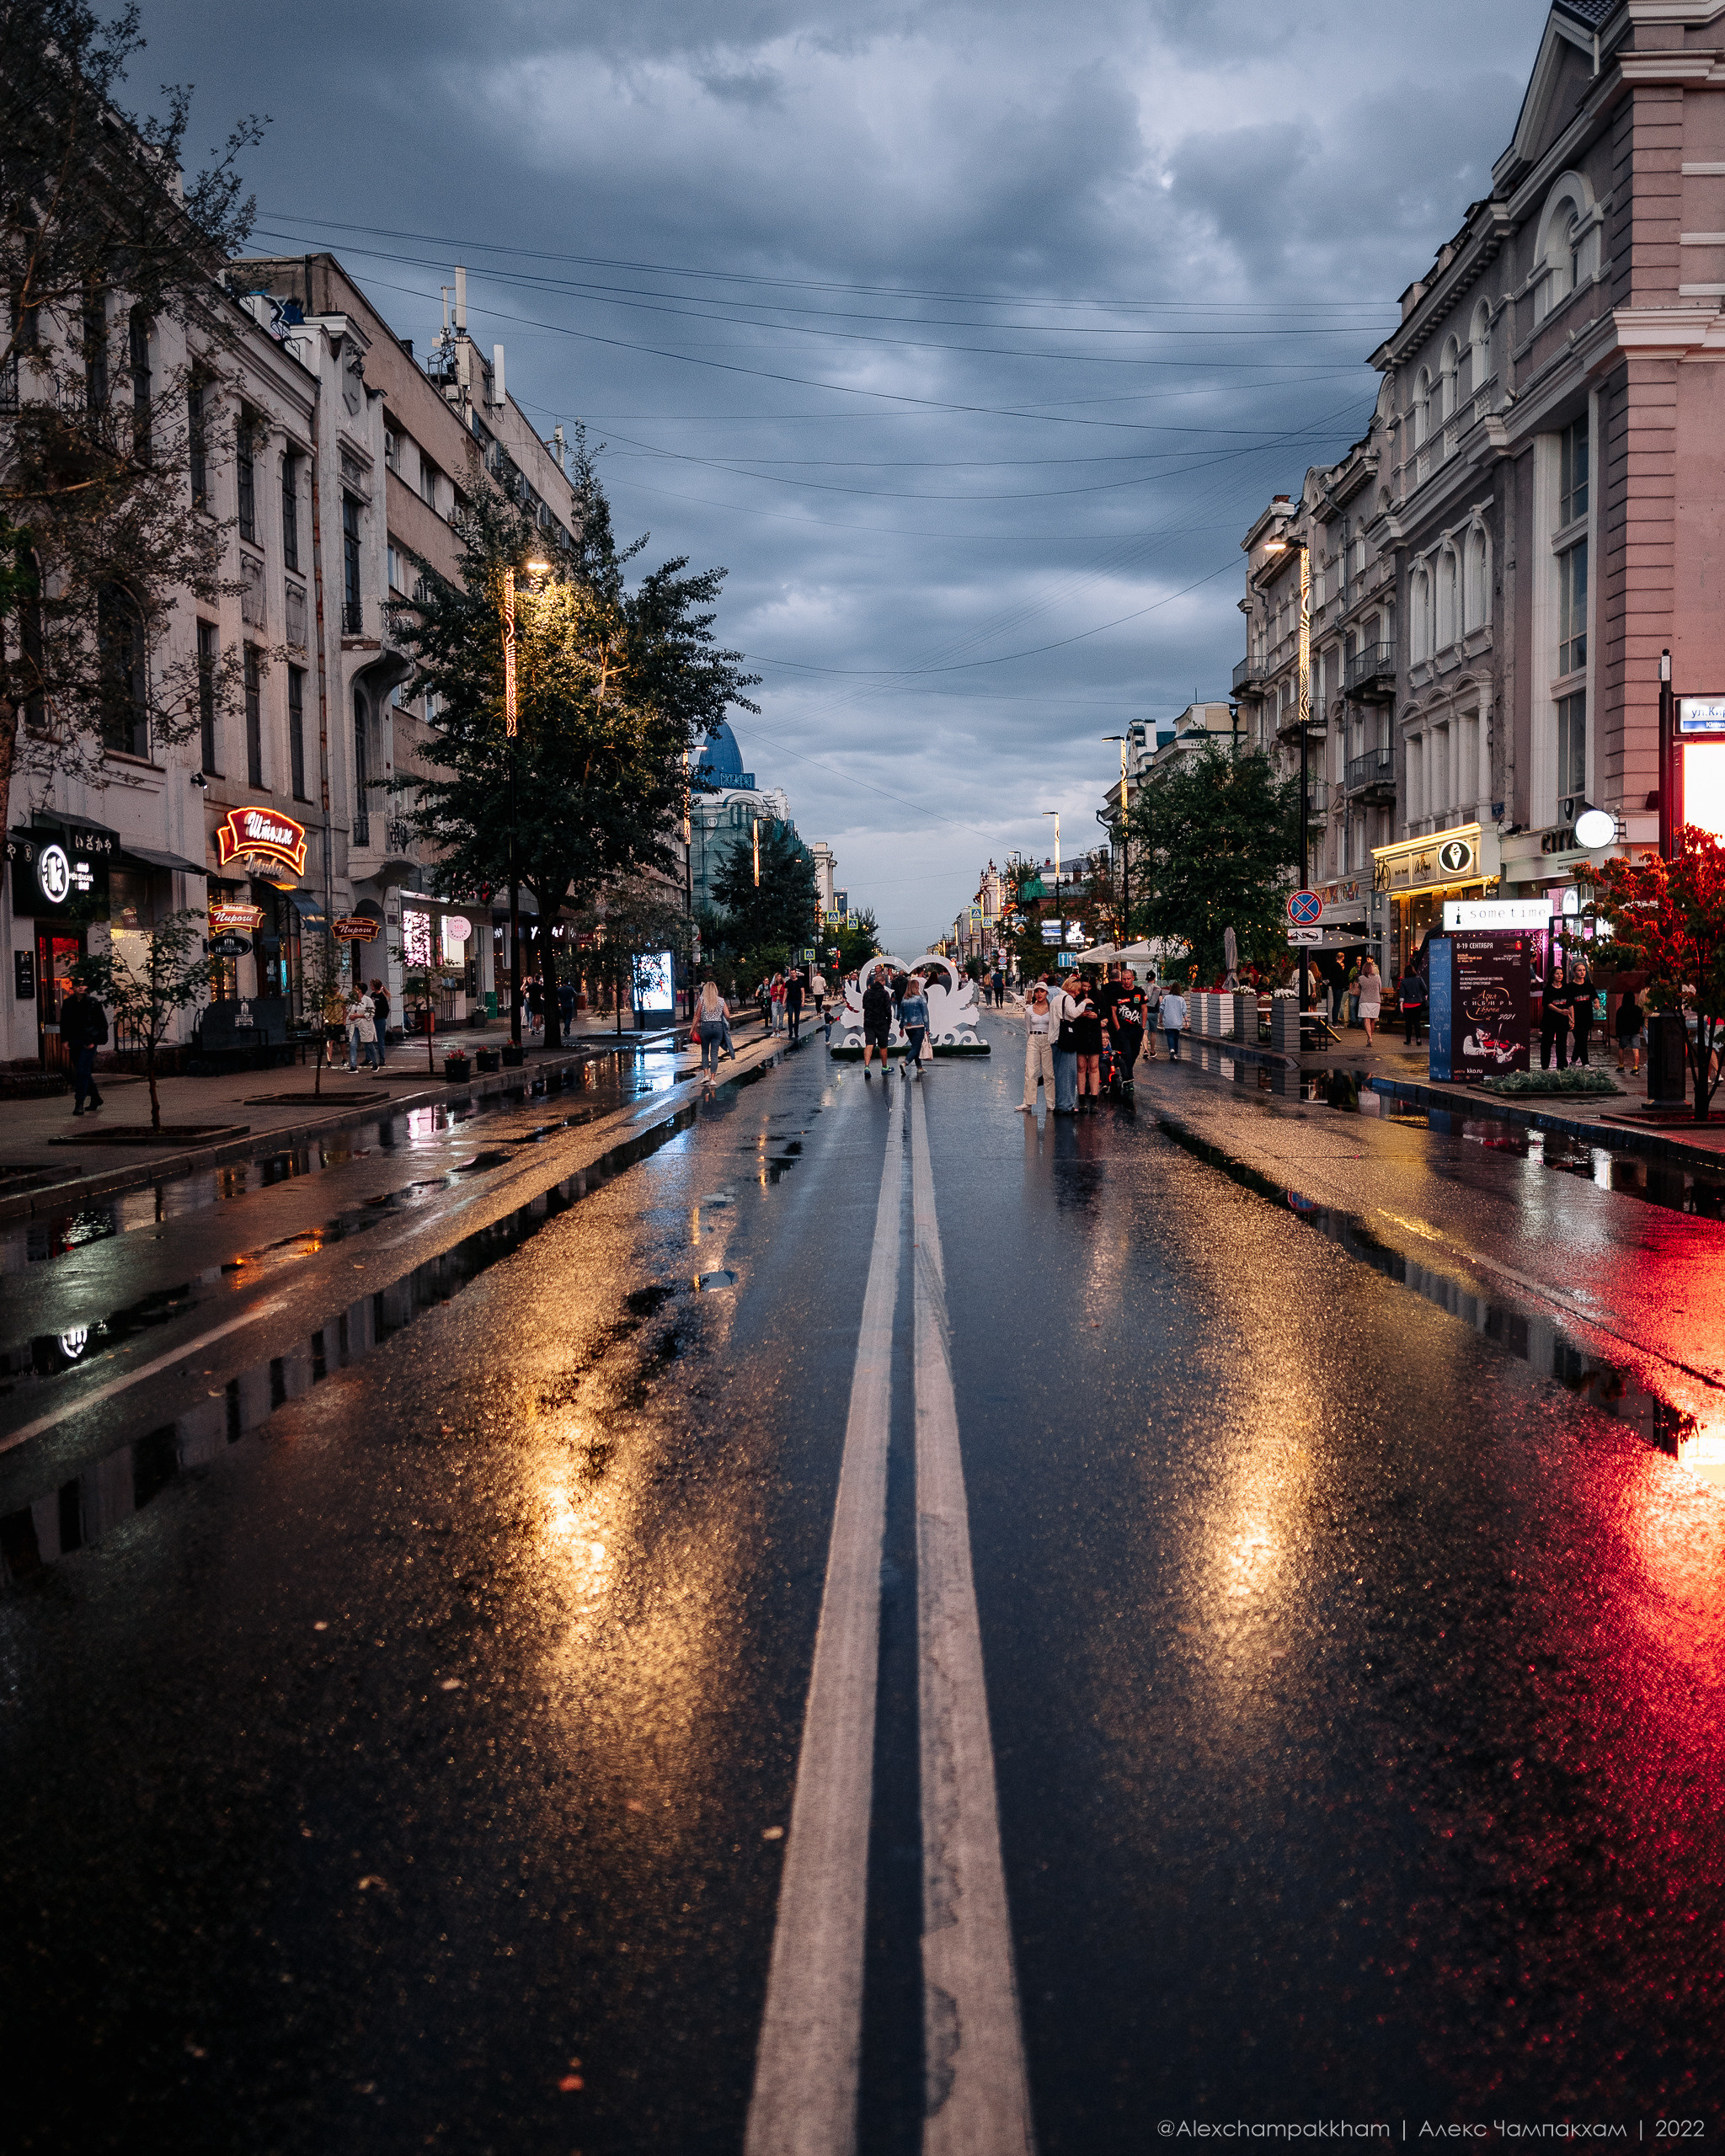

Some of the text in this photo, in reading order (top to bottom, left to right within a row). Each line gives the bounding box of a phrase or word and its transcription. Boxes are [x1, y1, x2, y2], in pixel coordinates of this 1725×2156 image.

[75, 835, 112, 854] いざかや
[213, 911, 254, 924] Пироги
[339, 925, 372, 935] Пироги
[1119, 1005, 1141, 1023] ROCK
